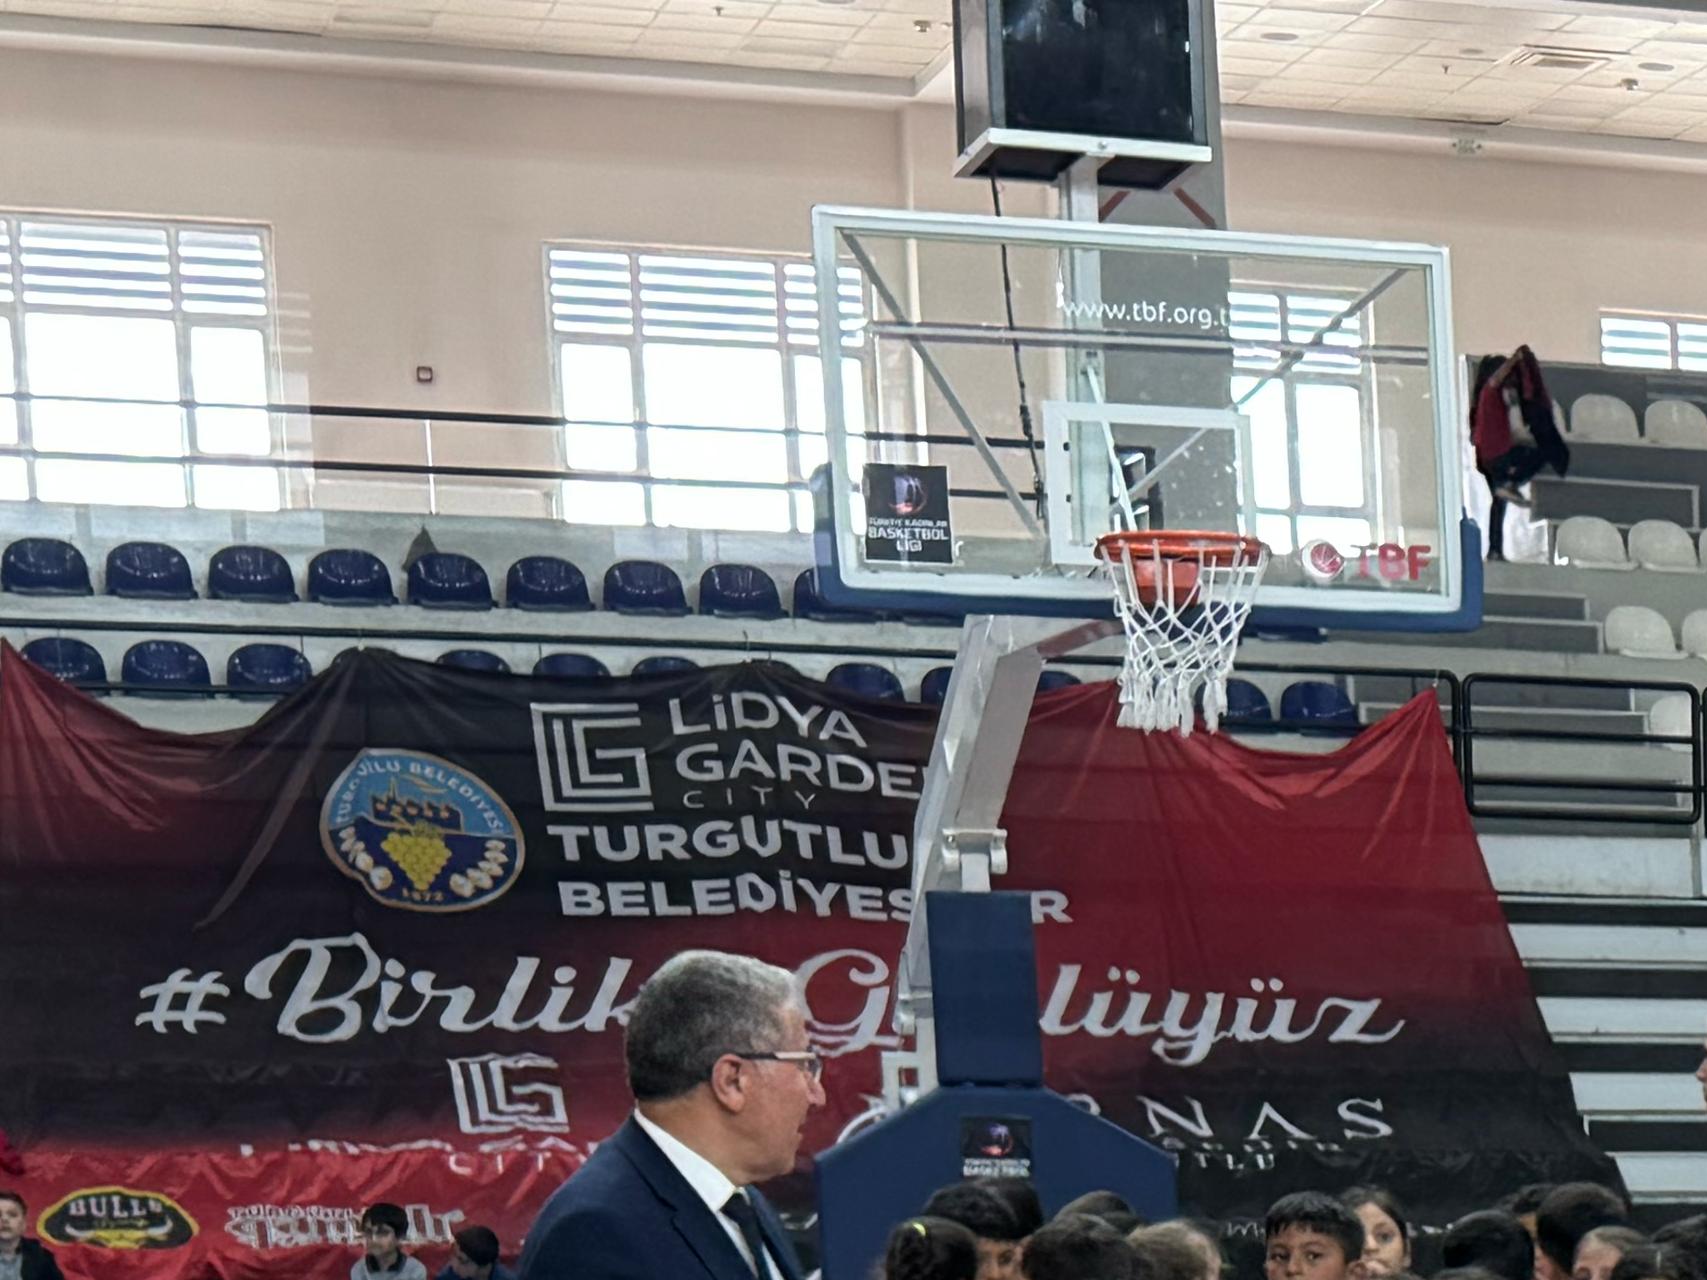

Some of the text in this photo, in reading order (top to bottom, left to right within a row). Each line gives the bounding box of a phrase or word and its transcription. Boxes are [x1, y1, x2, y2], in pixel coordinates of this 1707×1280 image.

[1062, 300, 1232, 329] www.tbf.org.t
[868, 526, 949, 541] BASKETBOL
[1351, 543, 1432, 581] TBF
[676, 739, 925, 799] GARDE
[682, 788, 817, 809] CITY
[546, 816, 908, 869] TURGUTLU
